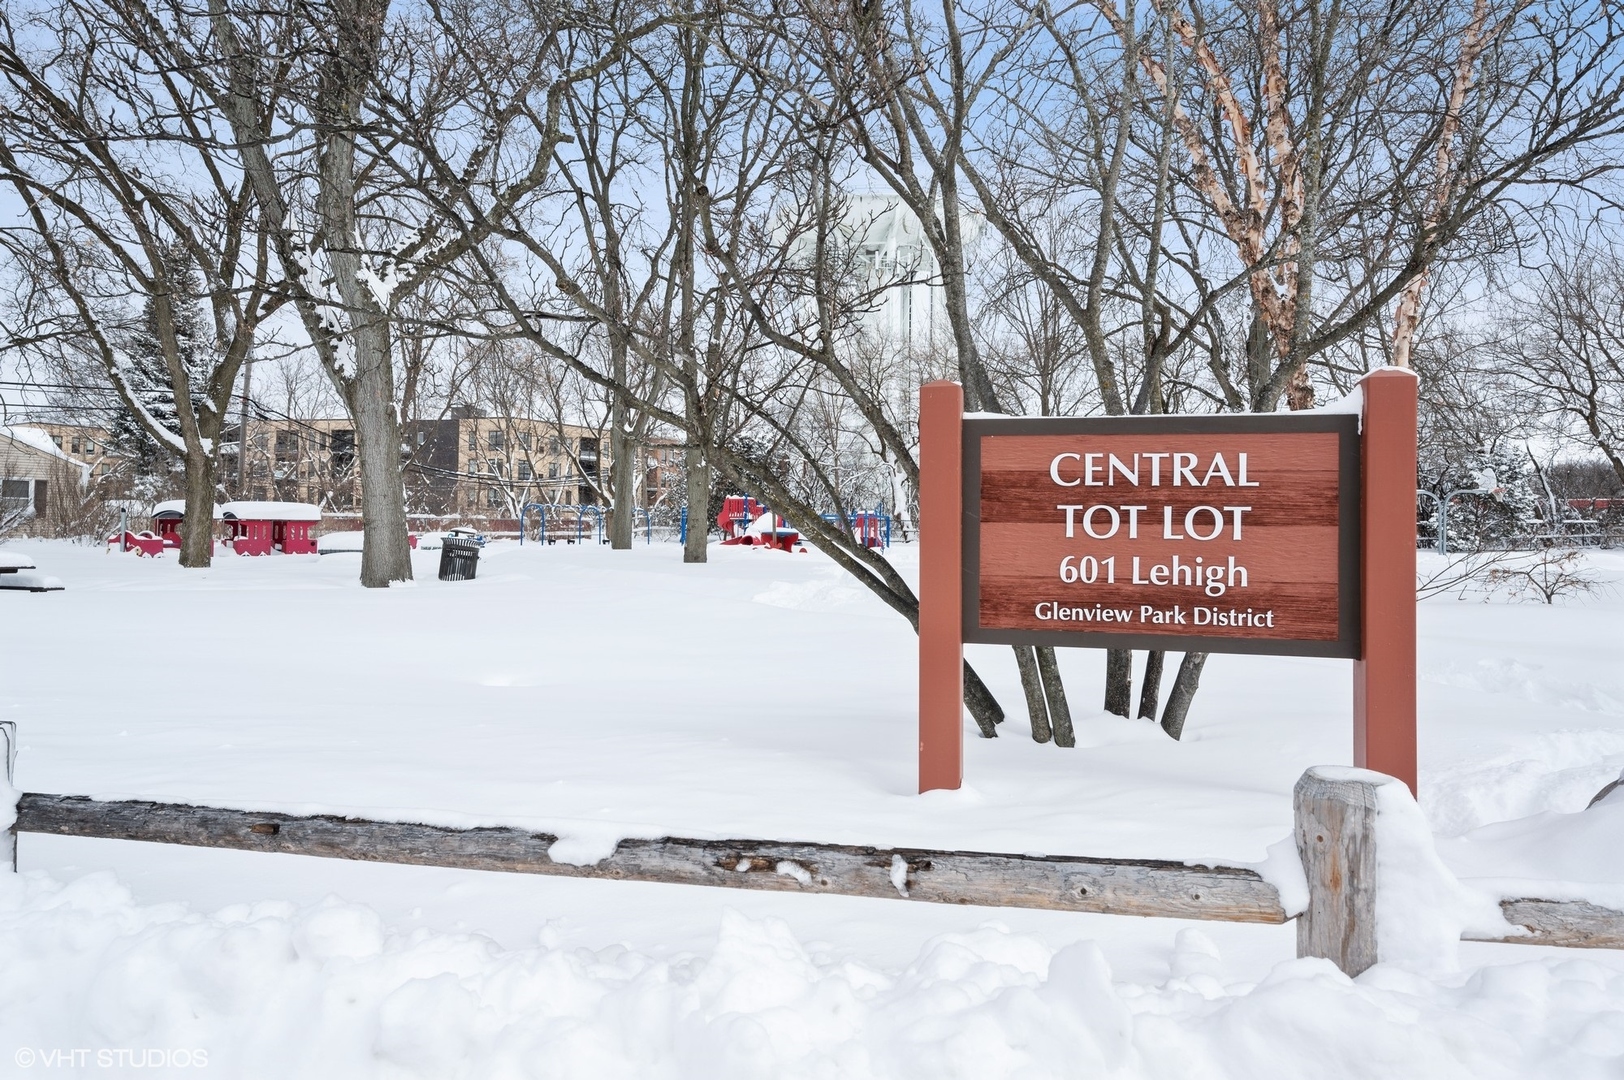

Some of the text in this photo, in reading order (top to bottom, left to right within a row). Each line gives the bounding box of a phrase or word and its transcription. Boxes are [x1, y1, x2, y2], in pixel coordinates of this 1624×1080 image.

[1049, 452, 1260, 487] CENTRAL
[1056, 504, 1252, 541] TOT LOT
[1059, 554, 1248, 597] 601 Lehigh
[1034, 601, 1275, 628] Glenview Park District
